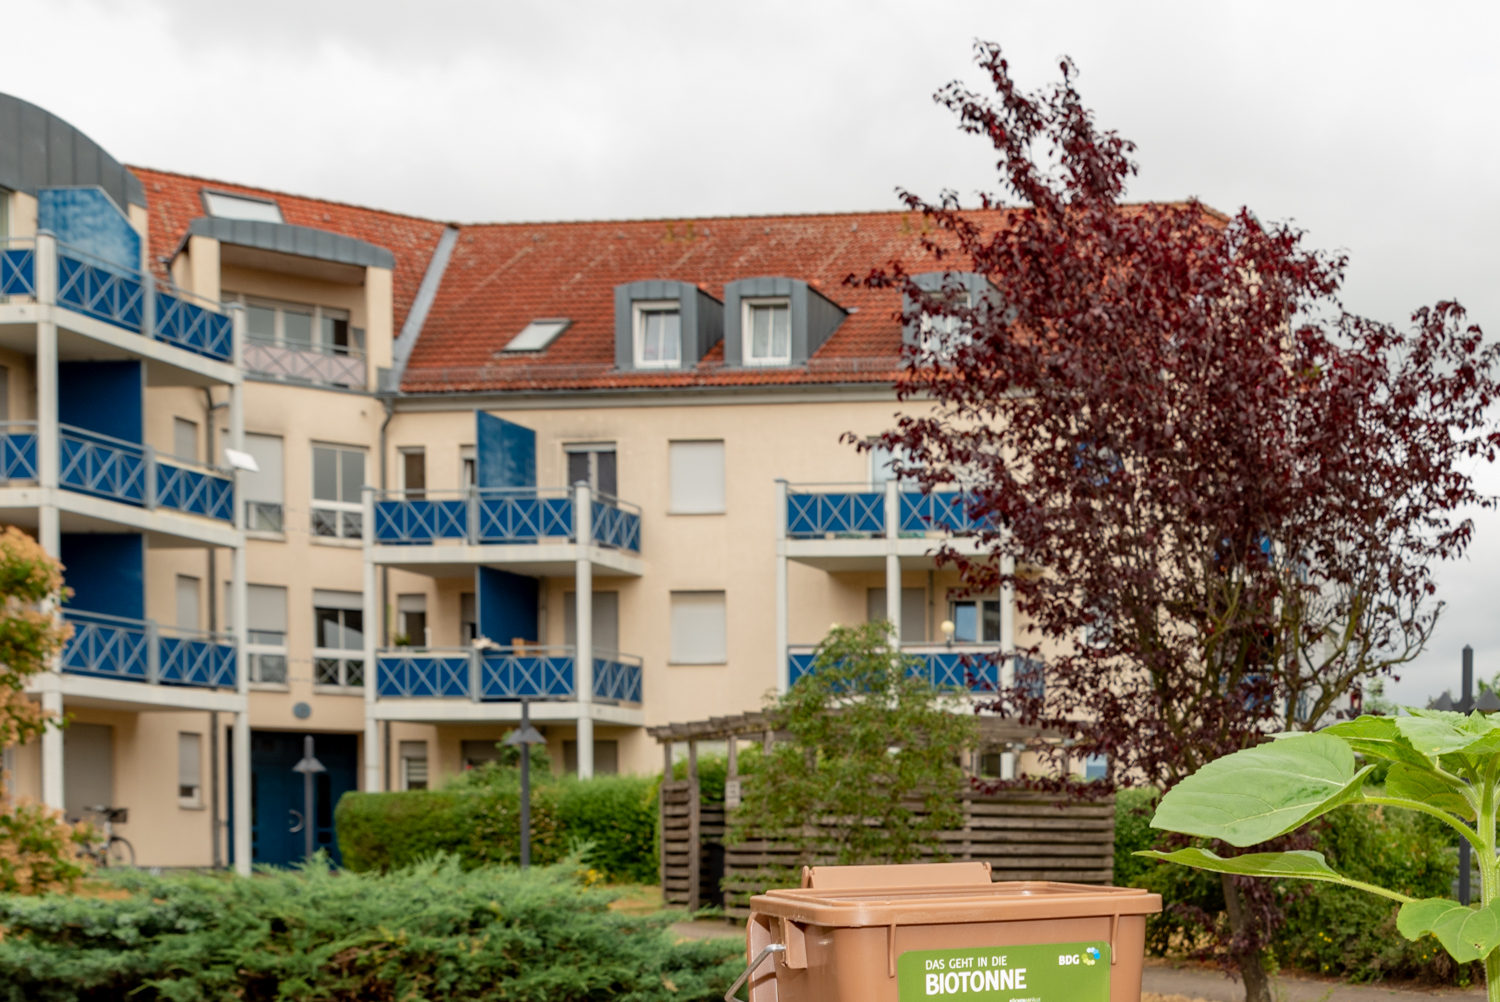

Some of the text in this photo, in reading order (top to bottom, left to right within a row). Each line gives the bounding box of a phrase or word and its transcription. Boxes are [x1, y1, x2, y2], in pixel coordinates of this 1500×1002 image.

[926, 956, 1007, 971] DAS GEHT IN DIE
[1059, 954, 1080, 966] BDG
[926, 968, 1027, 996] BIOTONNE
